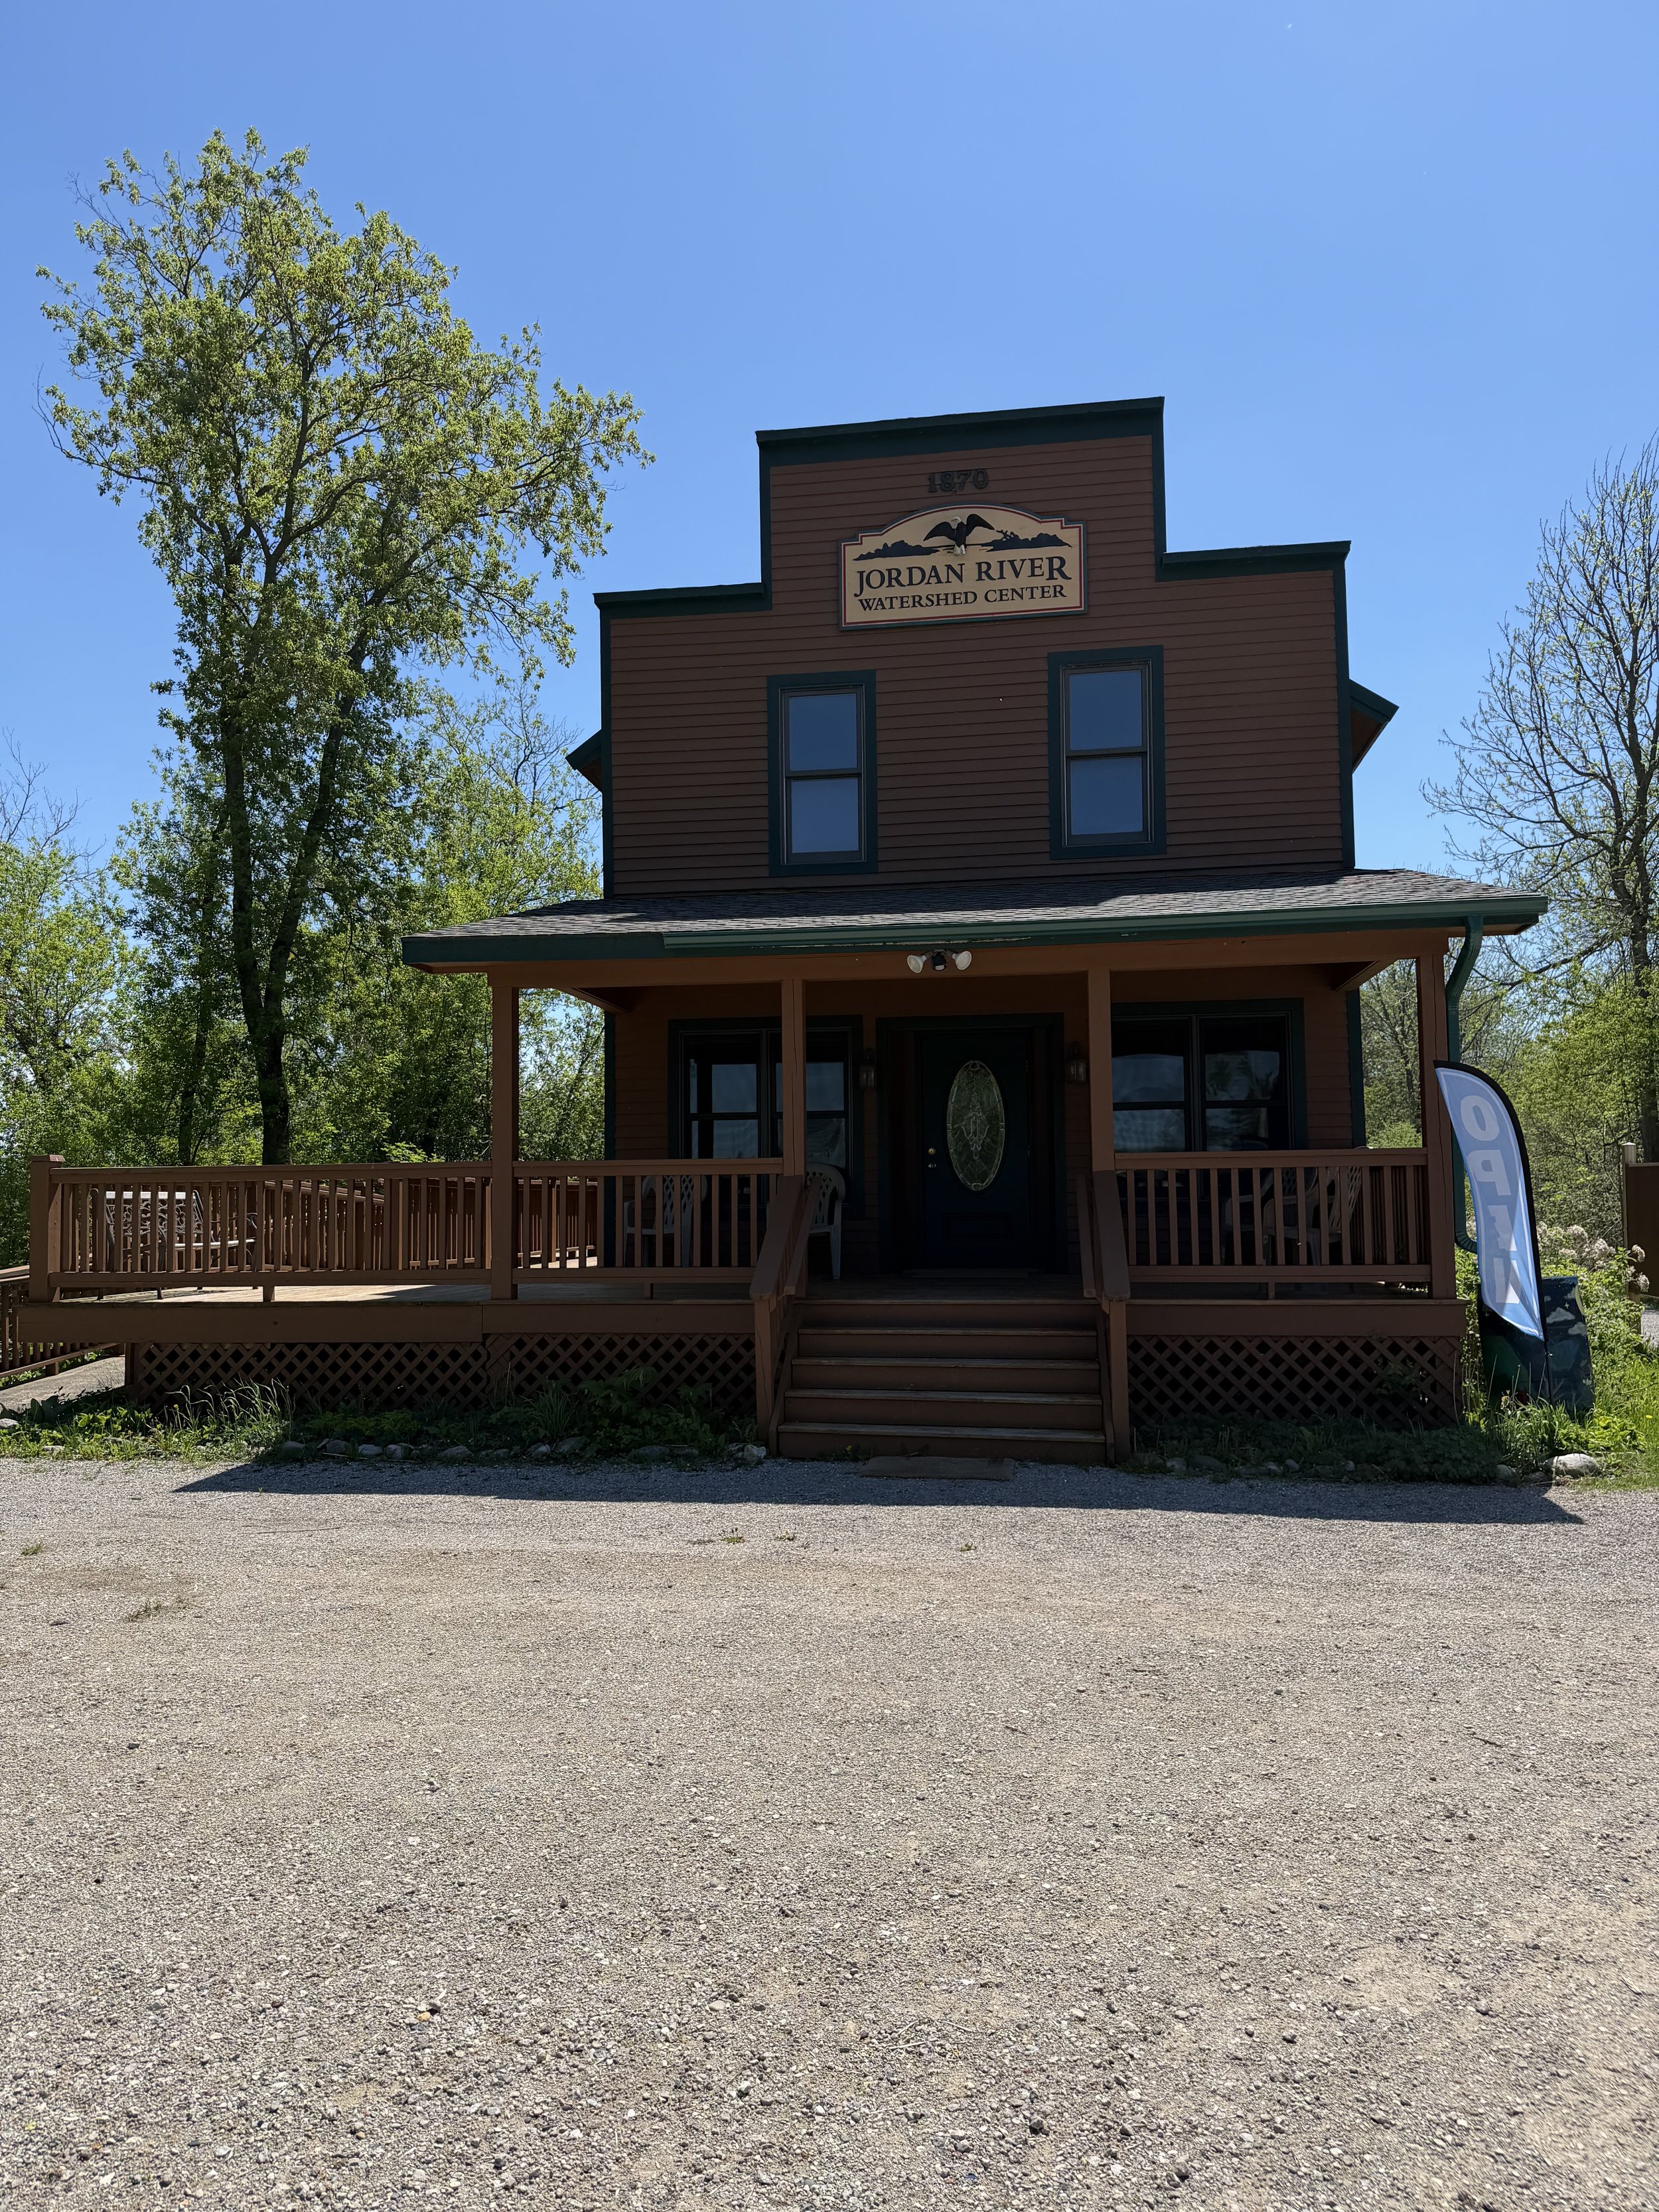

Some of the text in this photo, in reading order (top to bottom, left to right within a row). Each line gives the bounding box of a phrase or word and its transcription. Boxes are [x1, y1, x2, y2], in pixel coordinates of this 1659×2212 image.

[928, 469, 988, 492] 1870
[853, 555, 1072, 597] JORDAN RIVER
[858, 584, 1067, 611] WATERSHED CENTER
